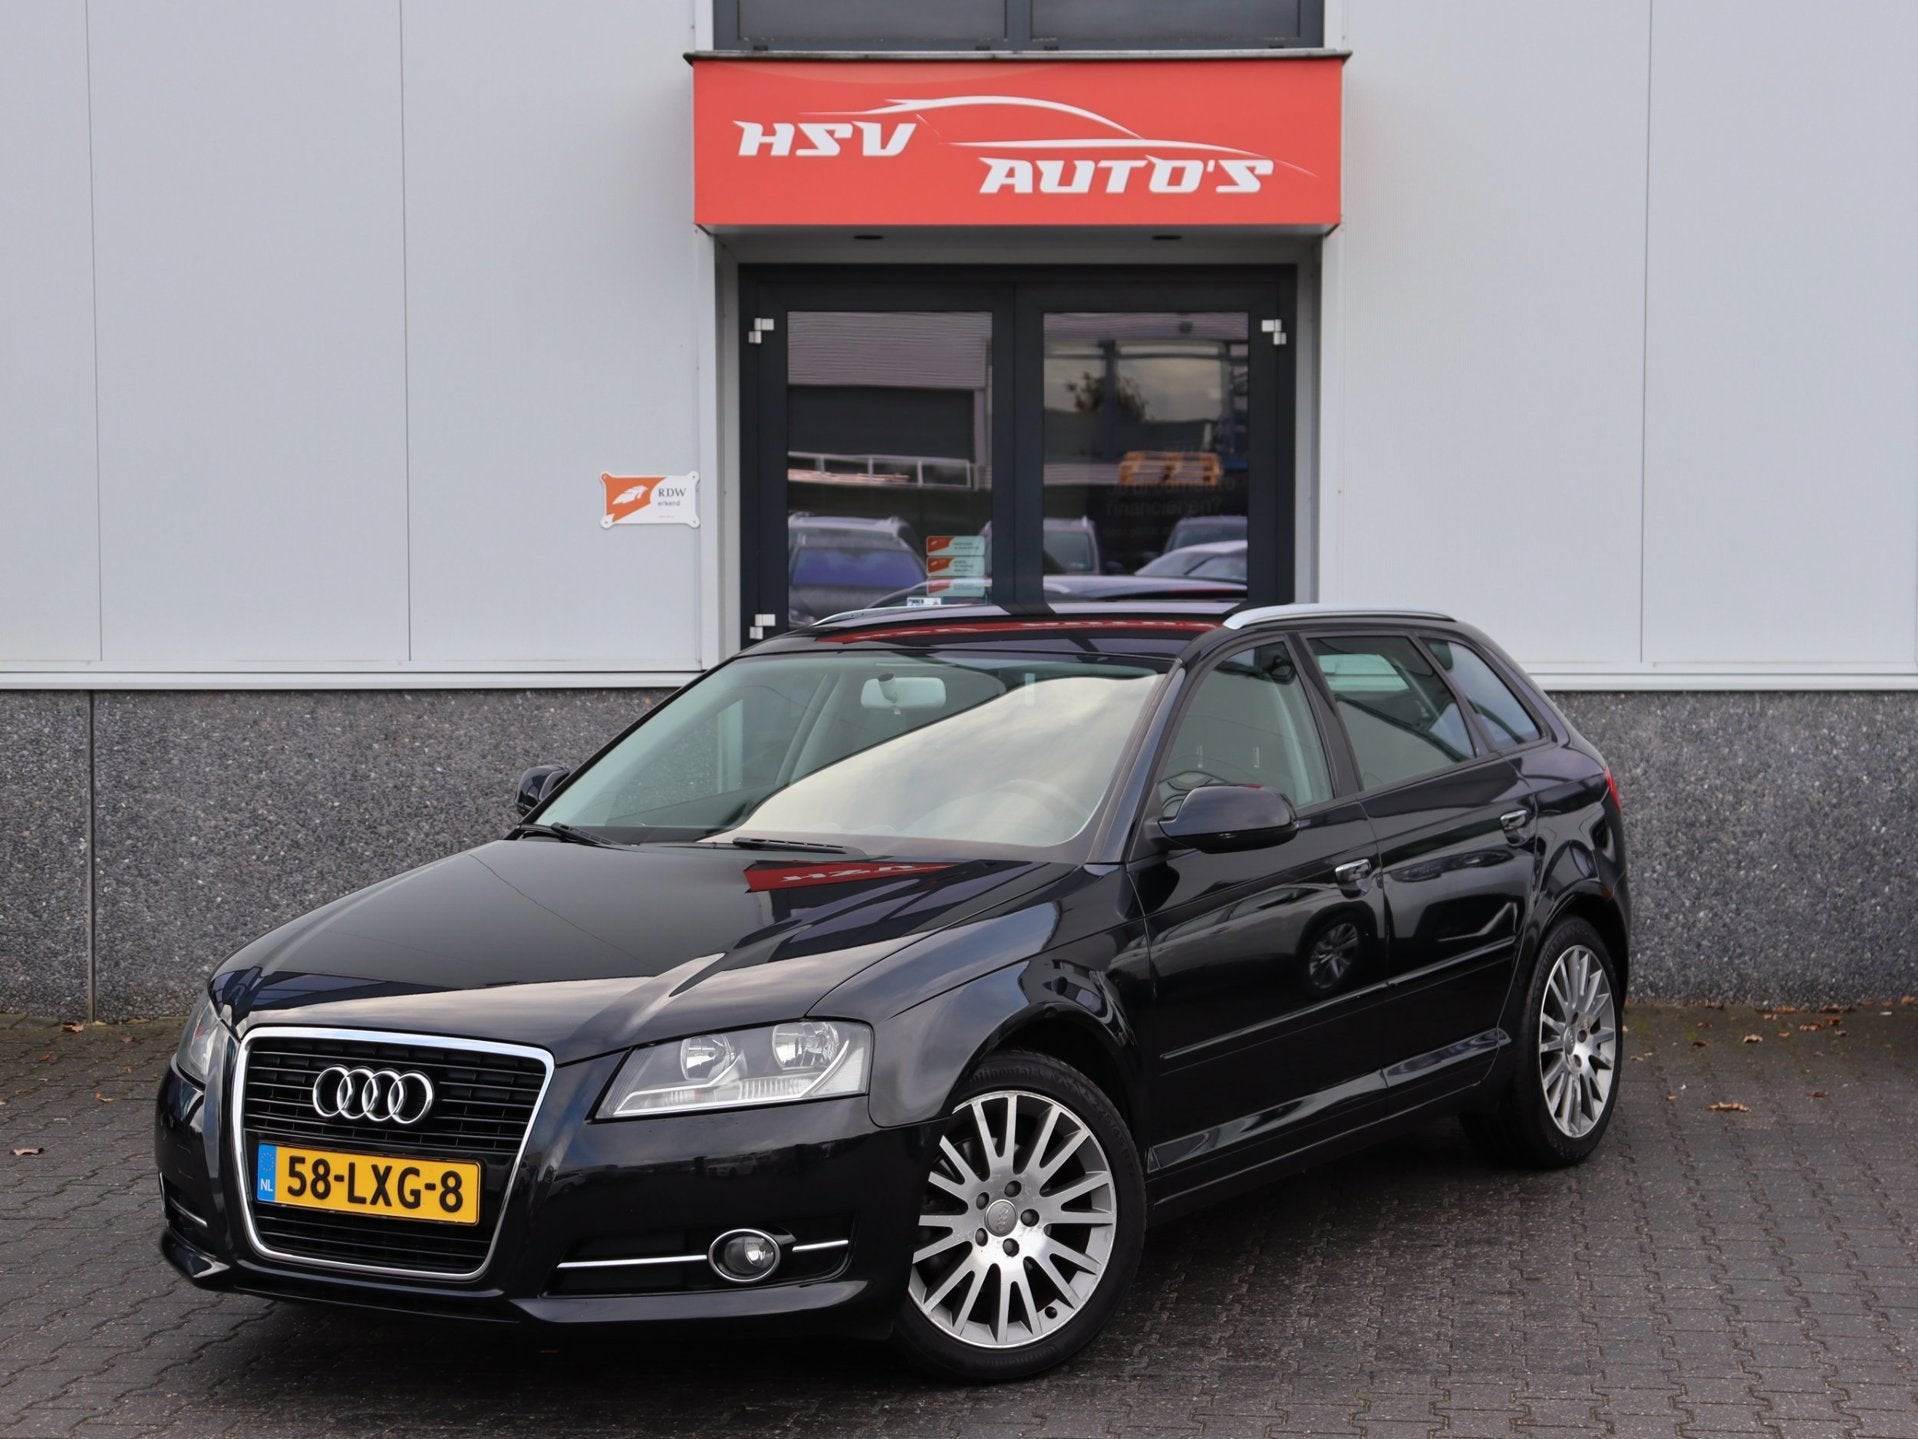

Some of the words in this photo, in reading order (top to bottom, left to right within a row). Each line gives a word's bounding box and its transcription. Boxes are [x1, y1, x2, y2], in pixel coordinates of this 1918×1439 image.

[732, 120, 917, 157] HSV
[977, 154, 1274, 194] AUTO'S
[658, 487, 687, 497] RDW
[260, 1178, 274, 1193] NL
[287, 1155, 463, 1213] 58-LXG-8
